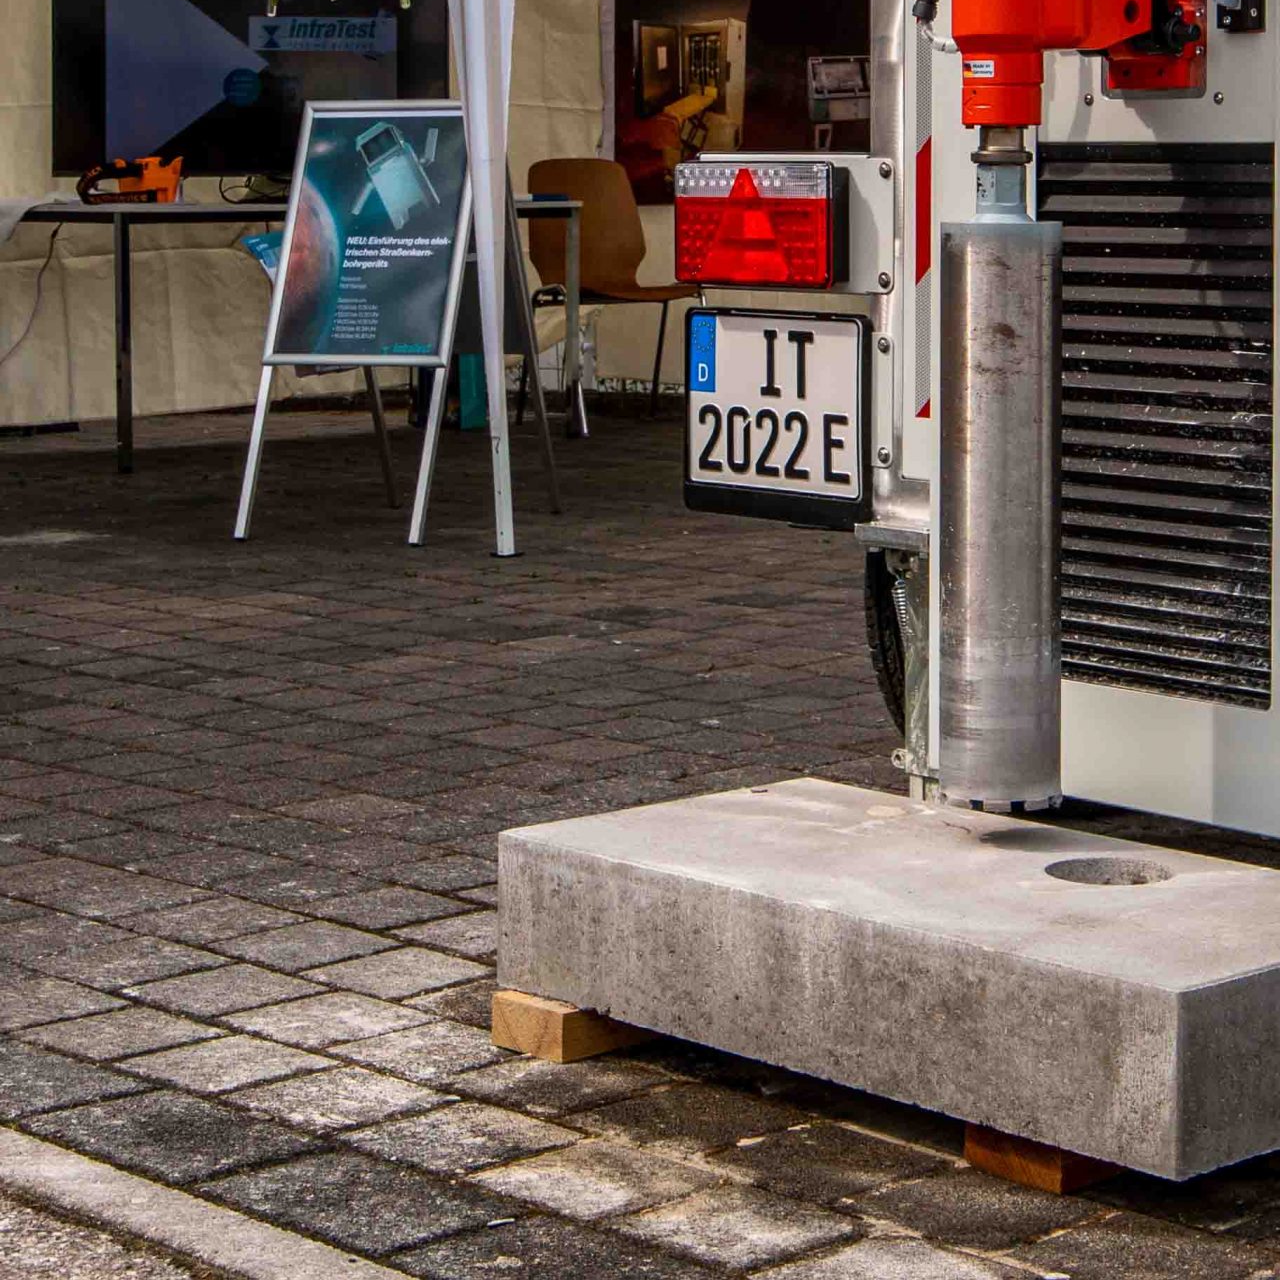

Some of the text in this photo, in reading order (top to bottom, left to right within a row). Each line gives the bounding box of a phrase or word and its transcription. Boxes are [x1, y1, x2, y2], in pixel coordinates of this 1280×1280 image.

[288, 19, 376, 39] infraTest
[414, 237, 430, 245] des
[698, 363, 709, 382] D
[760, 329, 816, 399] IT
